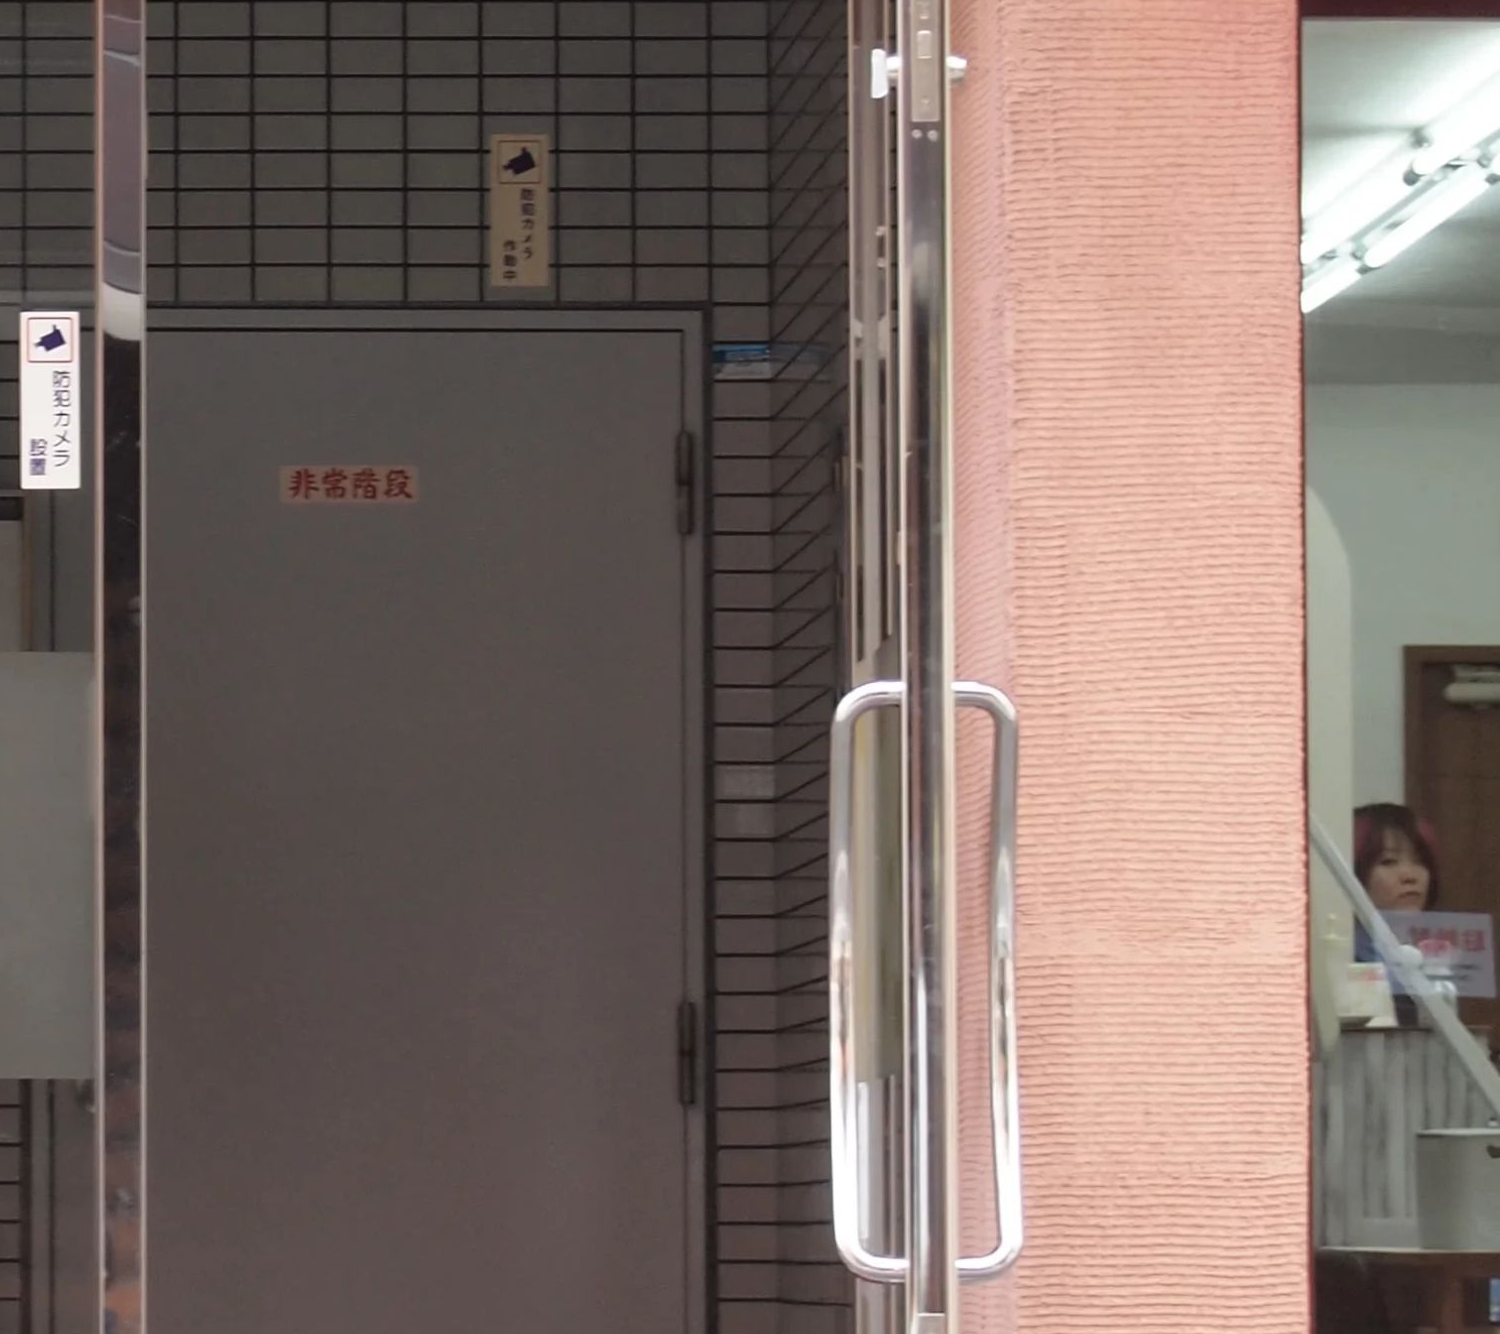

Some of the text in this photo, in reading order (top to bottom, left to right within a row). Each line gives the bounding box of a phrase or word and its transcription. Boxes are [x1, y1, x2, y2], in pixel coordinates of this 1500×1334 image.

[52, 369, 71, 468] 防犯カメラ
[29, 437, 48, 476] 設置
[287, 468, 414, 501] 非常階段
